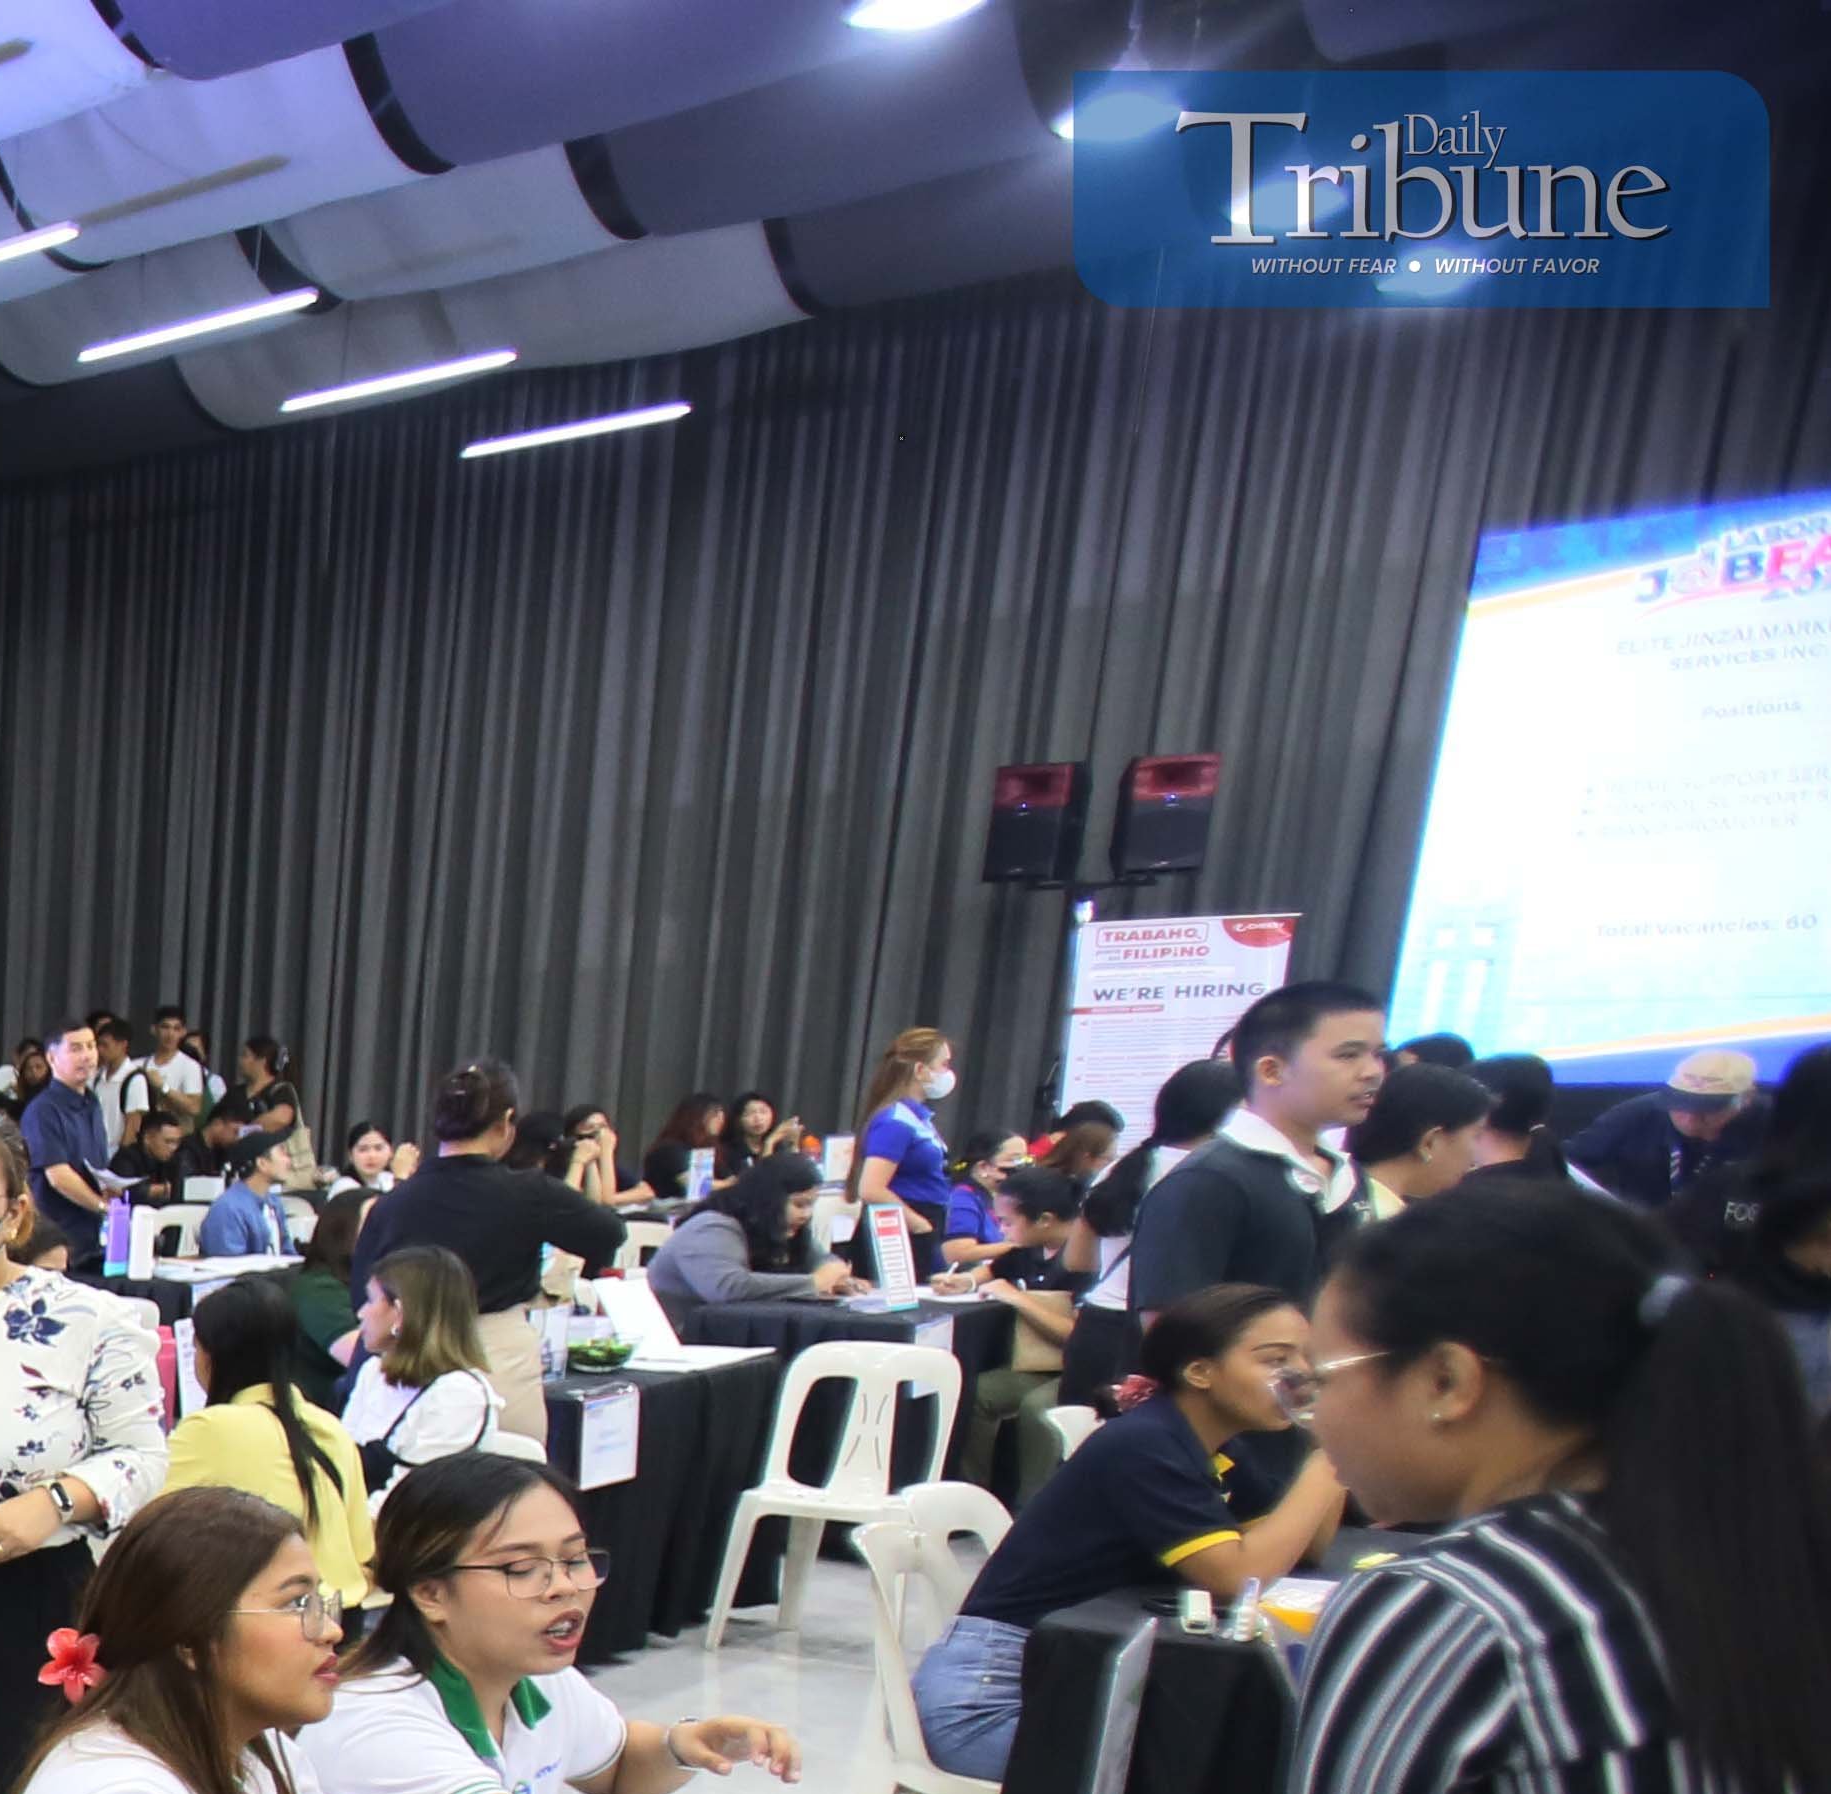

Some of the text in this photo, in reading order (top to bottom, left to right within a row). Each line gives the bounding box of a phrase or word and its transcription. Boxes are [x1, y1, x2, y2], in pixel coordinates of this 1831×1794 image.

[1669, 647, 1776, 672] SERVICES
[1700, 698, 1803, 720] Positions
[1785, 912, 1819, 931] 60
[1092, 982, 1266, 1001] WE'RE HIRING
